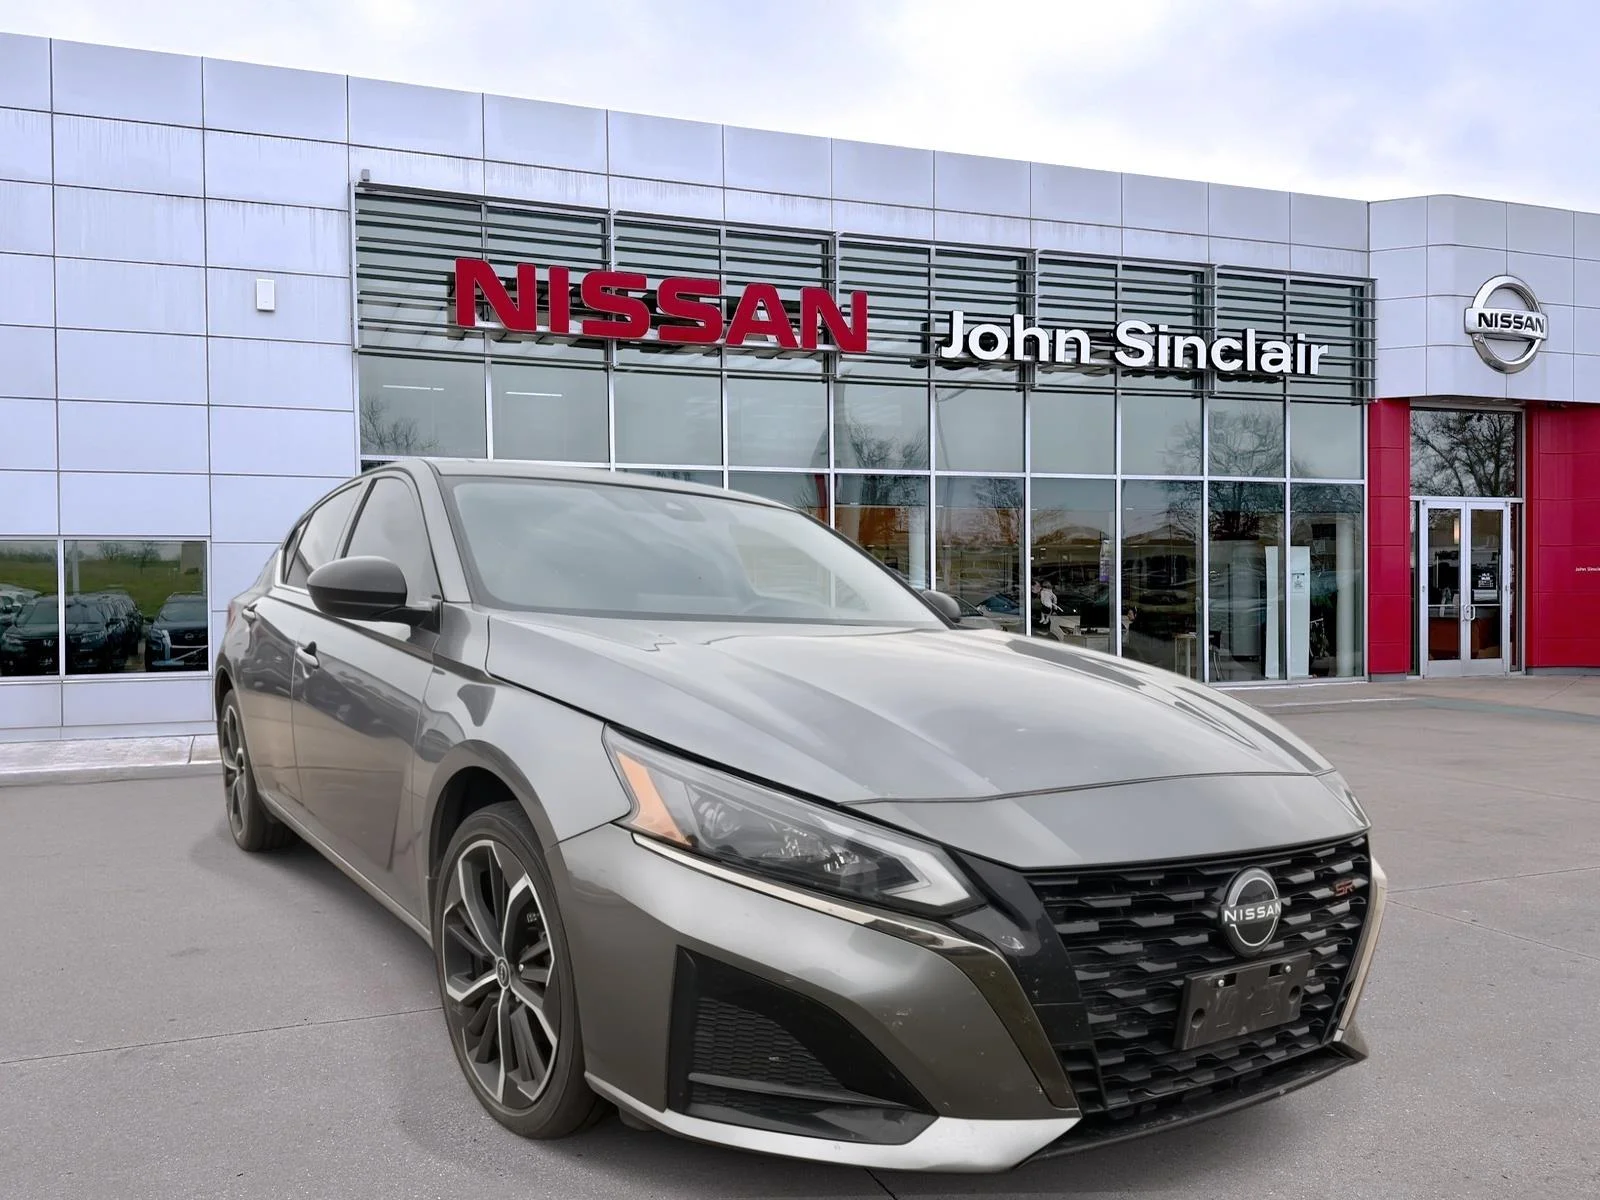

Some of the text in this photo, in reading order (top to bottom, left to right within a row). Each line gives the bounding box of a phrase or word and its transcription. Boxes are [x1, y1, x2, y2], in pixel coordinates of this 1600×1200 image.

[455, 257, 868, 352] NISSAN
[1477, 312, 1545, 333] NISSAN
[940, 310, 1329, 375] John Sinclair
[1224, 902, 1281, 922] NISSAN
